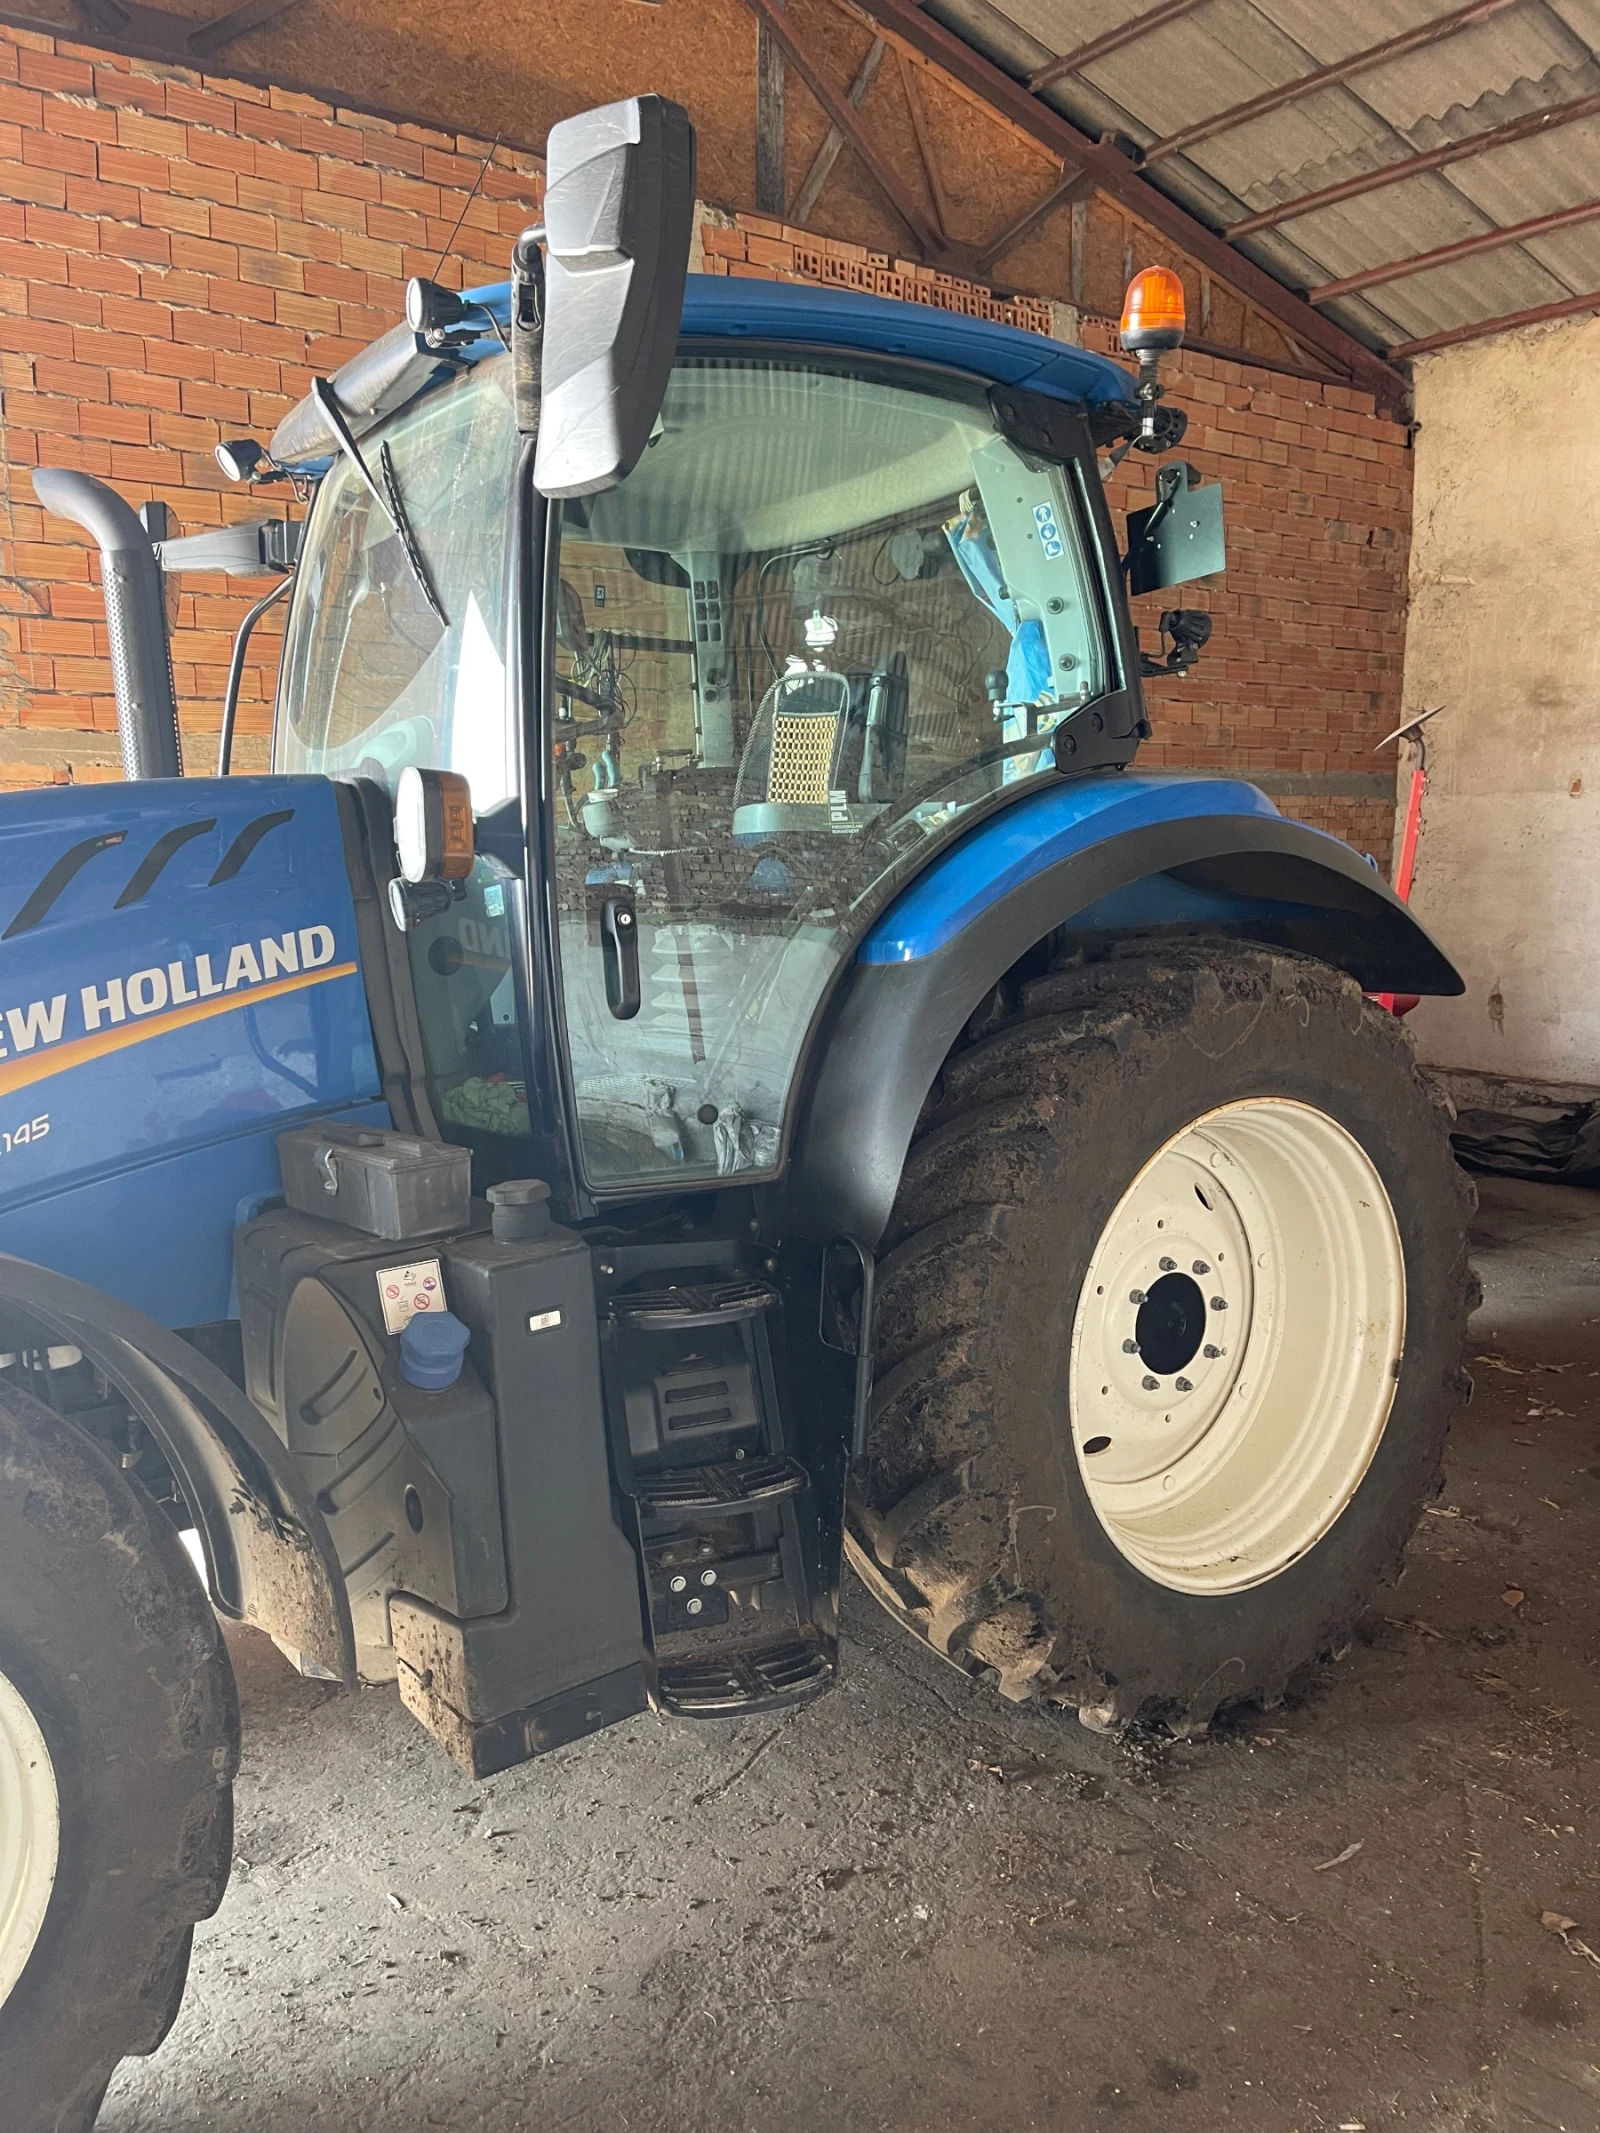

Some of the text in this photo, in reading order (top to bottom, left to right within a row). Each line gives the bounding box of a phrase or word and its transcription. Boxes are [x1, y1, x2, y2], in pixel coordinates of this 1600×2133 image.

[829, 790, 848, 821] PLM
[0, 925, 335, 1059] W HOLLAND
